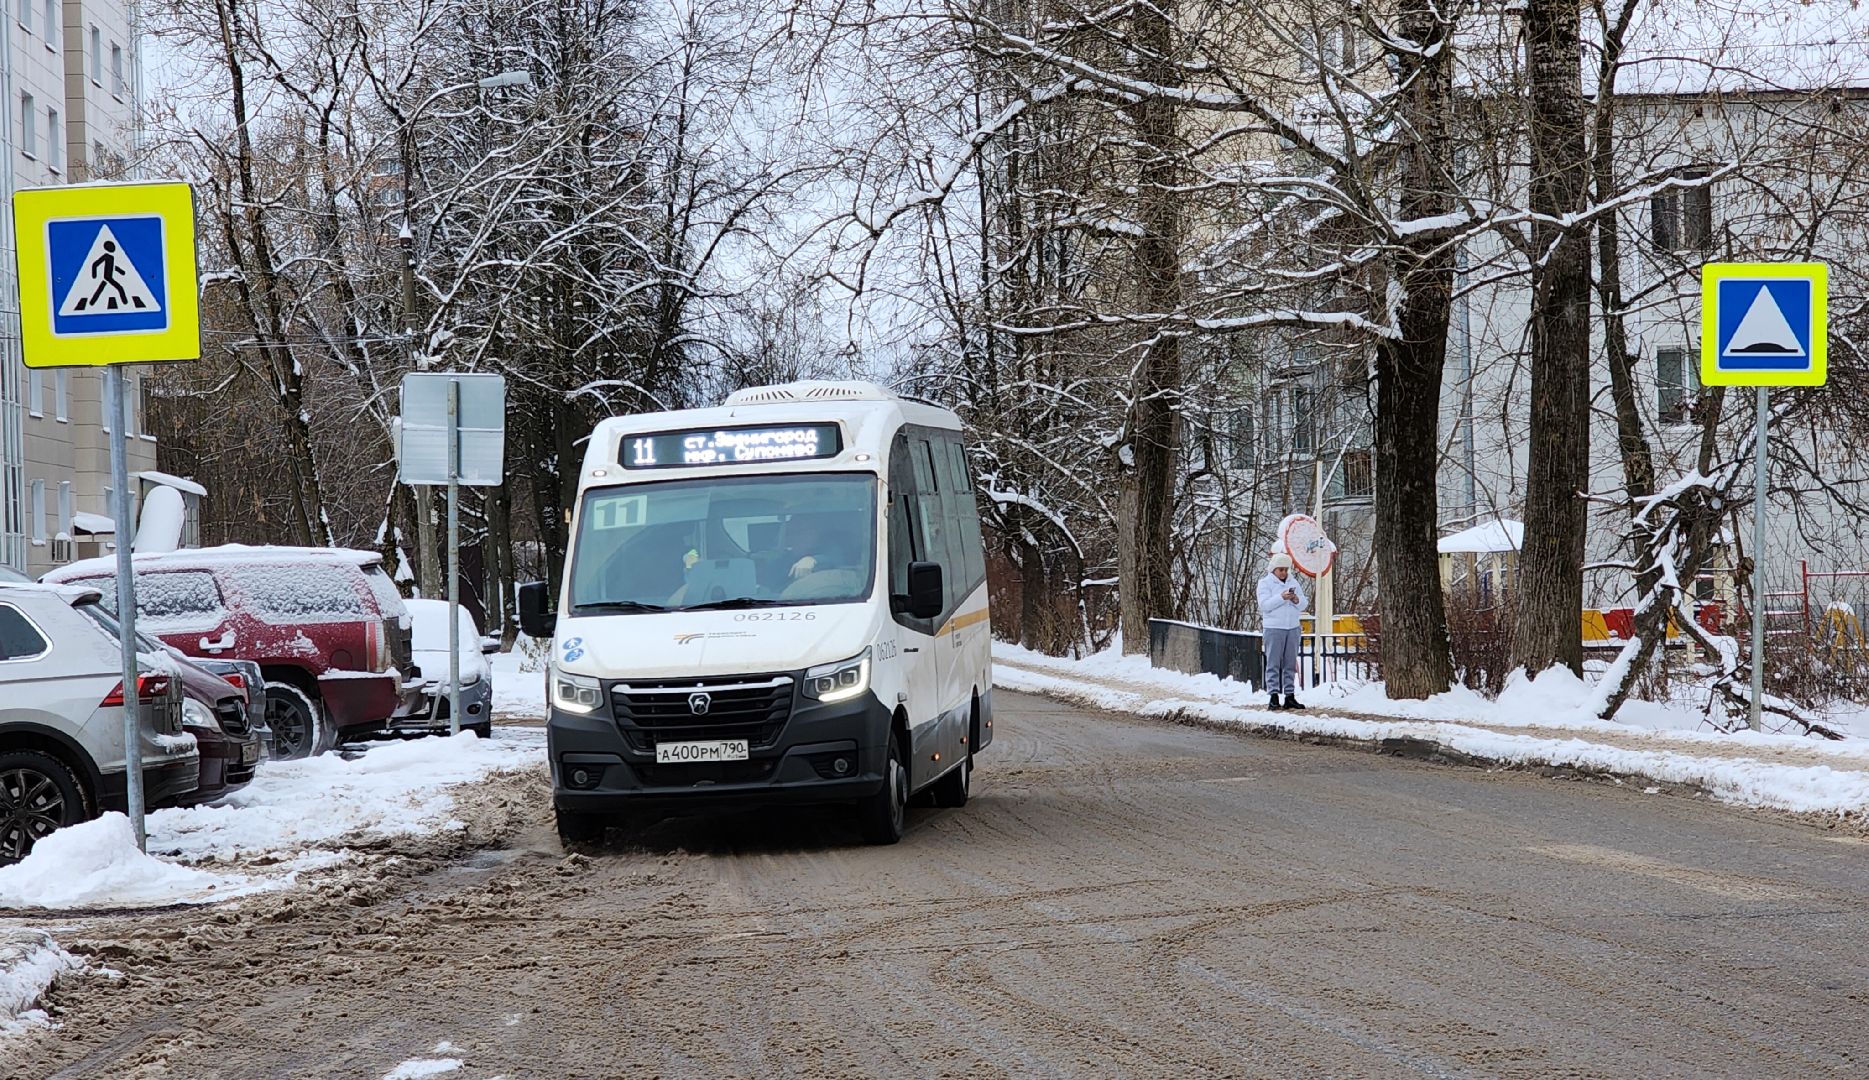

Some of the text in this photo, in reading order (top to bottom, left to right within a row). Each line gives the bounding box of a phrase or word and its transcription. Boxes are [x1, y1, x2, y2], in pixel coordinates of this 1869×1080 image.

[634, 438, 656, 464] 11
[596, 500, 639, 526] 11
[733, 611, 816, 622] 062126
